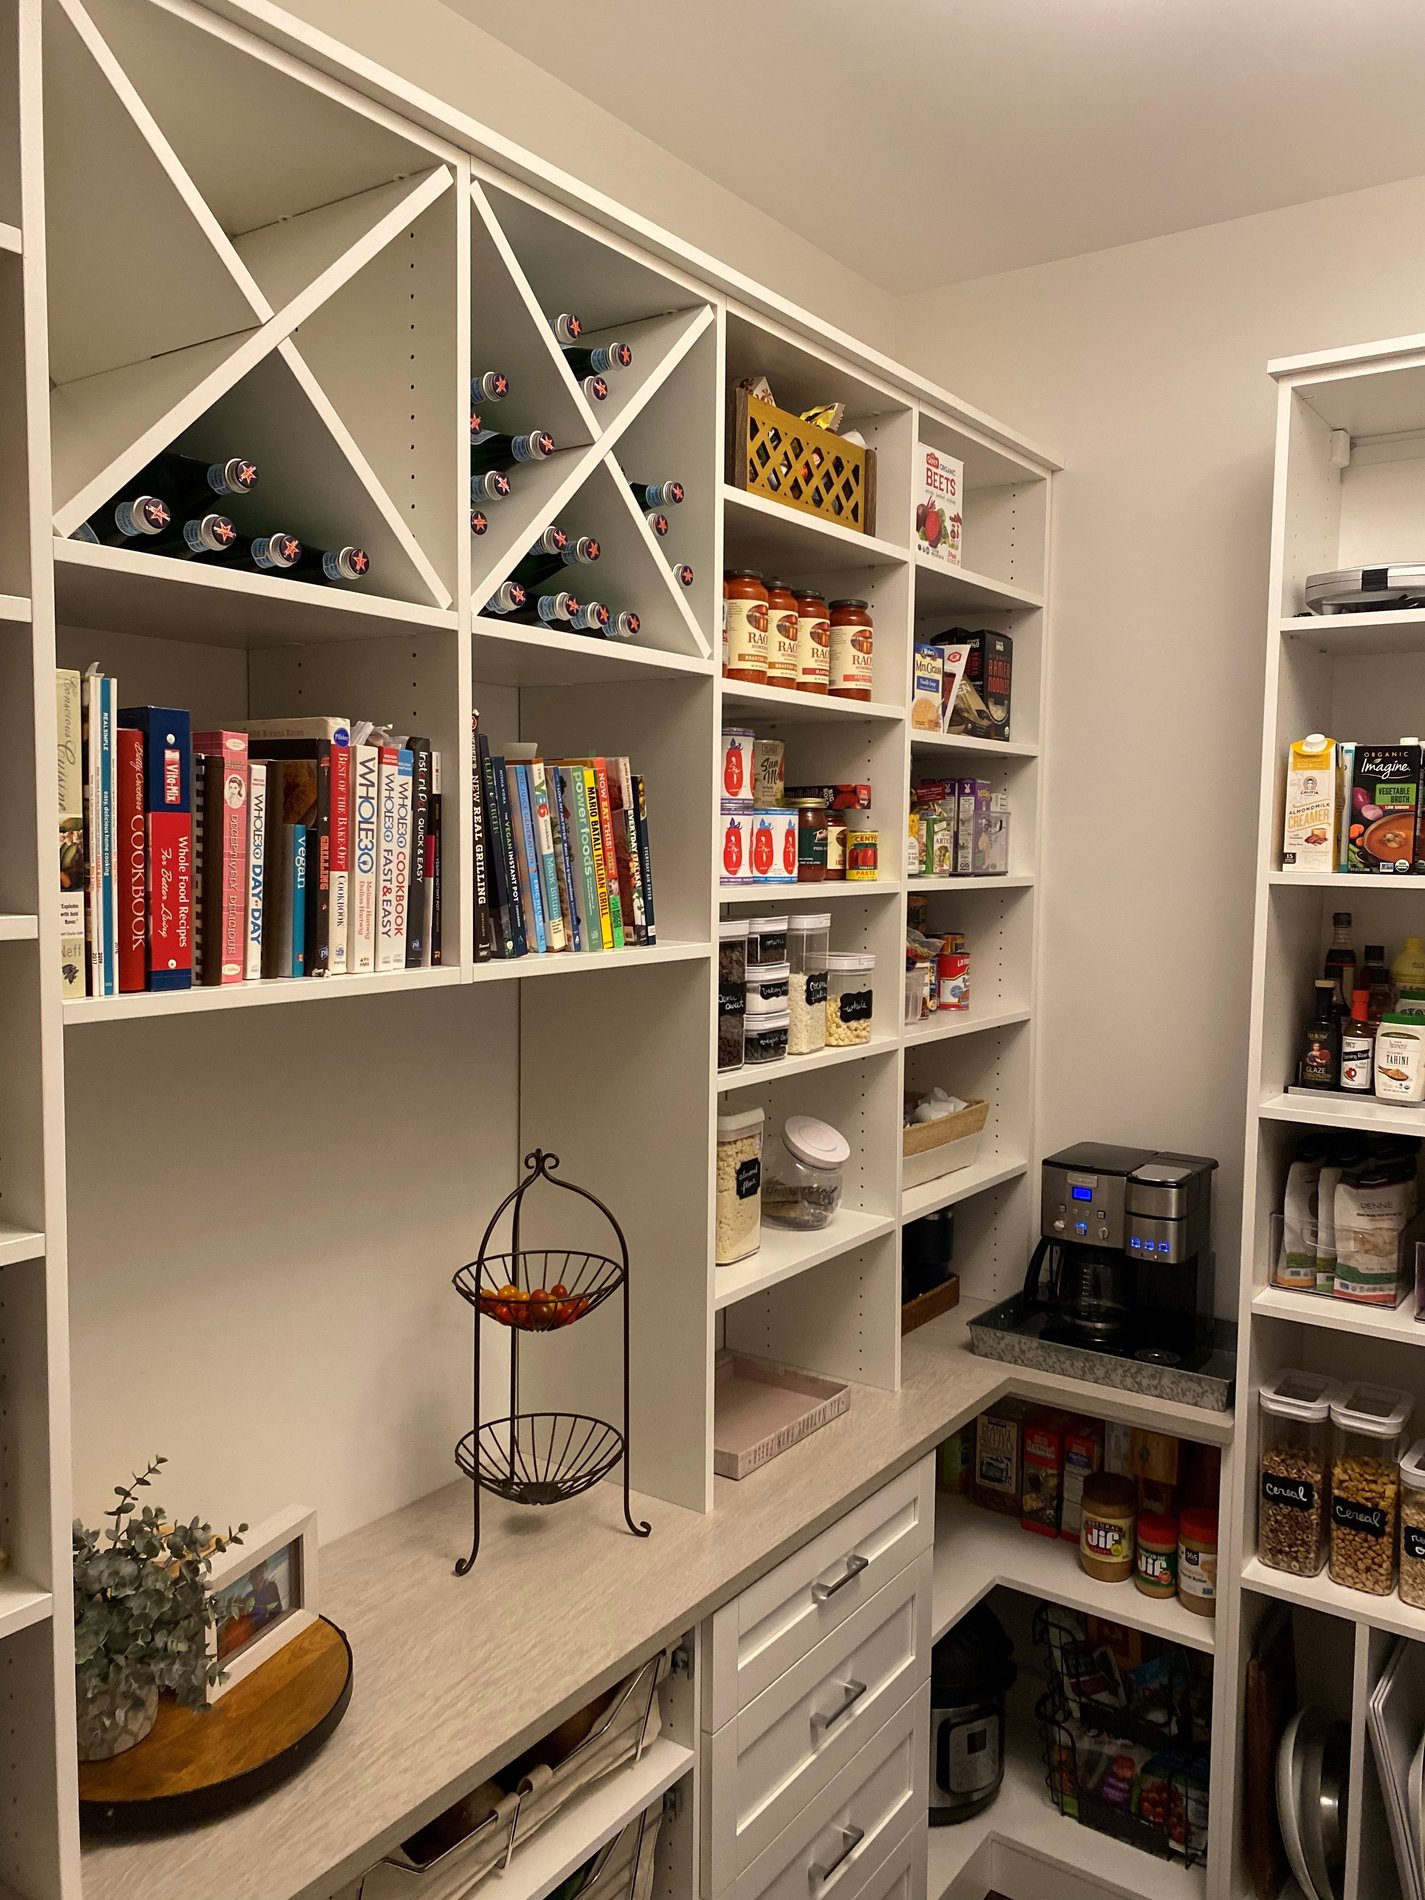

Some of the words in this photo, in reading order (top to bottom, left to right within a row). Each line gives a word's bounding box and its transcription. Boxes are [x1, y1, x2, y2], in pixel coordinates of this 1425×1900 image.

[926, 467, 956, 496] BEETS
[338, 753, 348, 778] BEST
[418, 751, 428, 790] Instant
[1361, 758, 1409, 779] Imagine
[338, 780, 346, 794] OF
[418, 792, 428, 812] Pot
[472, 775, 480, 802] NEW
[588, 787, 597, 817] MARIO
[598, 773, 606, 798] NOW
[1378, 787, 1410, 795] VEGETABLE
[338, 796, 346, 814] THE
[358, 757, 375, 874] WHOLE30
[384, 774, 394, 843] WHOLE30
[397, 782, 409, 848] WHOLE30
[473, 805, 482, 840] REAL
[1288, 809, 1329, 829] CREAMER
[1289, 803, 1330, 815] ALMONDMILK
[254, 794, 264, 859] WHOLE30
[336, 817, 347, 866] BAKE-OFF
[524, 812, 534, 864] GENERATION
[573, 772, 587, 825] power
[580, 827, 592, 876] foods
[592, 821, 601, 851] BATALI
[160, 848, 172, 865] For
[178, 836, 188, 872] Whole
[229, 814, 238, 890] DECEPTIVELY
[295, 836, 306, 889] vegan
[628, 810, 638, 853] EVERYDAY
[633, 854, 641, 887] ITALIAN
[130, 814, 145, 951] COOKBOOK
[161, 866, 172, 902] Better
[252, 865, 262, 900] DAY
[382, 850, 393, 886] FAST
[416, 857, 424, 883] EASY
[475, 845, 486, 904] GRILLING
[546, 857, 555, 884] Mark
[595, 854, 606, 889] ITALIAN
[178, 876, 188, 903] Food
[336, 875, 346, 927] COOKBOOK
[394, 852, 406, 936] COOKBOOK
[599, 891, 608, 918] GRILL
[158, 903, 170, 937] Living
[176, 906, 187, 948] Recipes
[228, 896, 237, 954] DELICIOUS
[251, 908, 261, 945] DAY
[381, 900, 392, 938] EASY
[1386, 1055, 1409, 1065] TAHINI
[739, 1165, 758, 1180] almond
[1087, 1528, 1120, 1549] Jif
[1138, 1554, 1167, 1576] Jif
